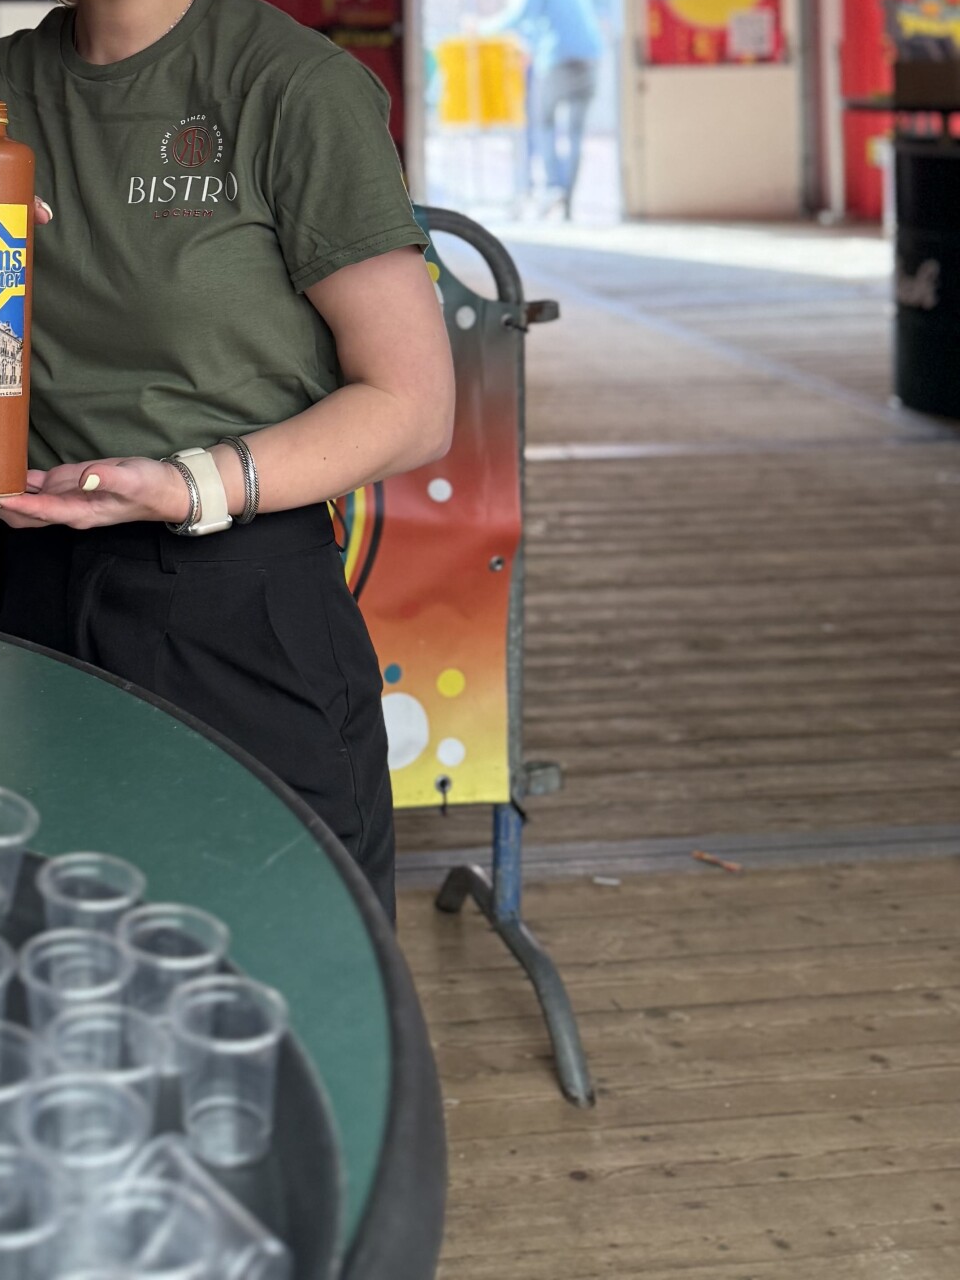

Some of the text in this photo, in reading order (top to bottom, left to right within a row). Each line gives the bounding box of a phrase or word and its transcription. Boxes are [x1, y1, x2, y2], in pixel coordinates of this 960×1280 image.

[160, 114, 223, 164] LUNCH DINER BORREL
[128, 171, 238, 204] BISTRO
[153, 208, 214, 220] LOCHEM
